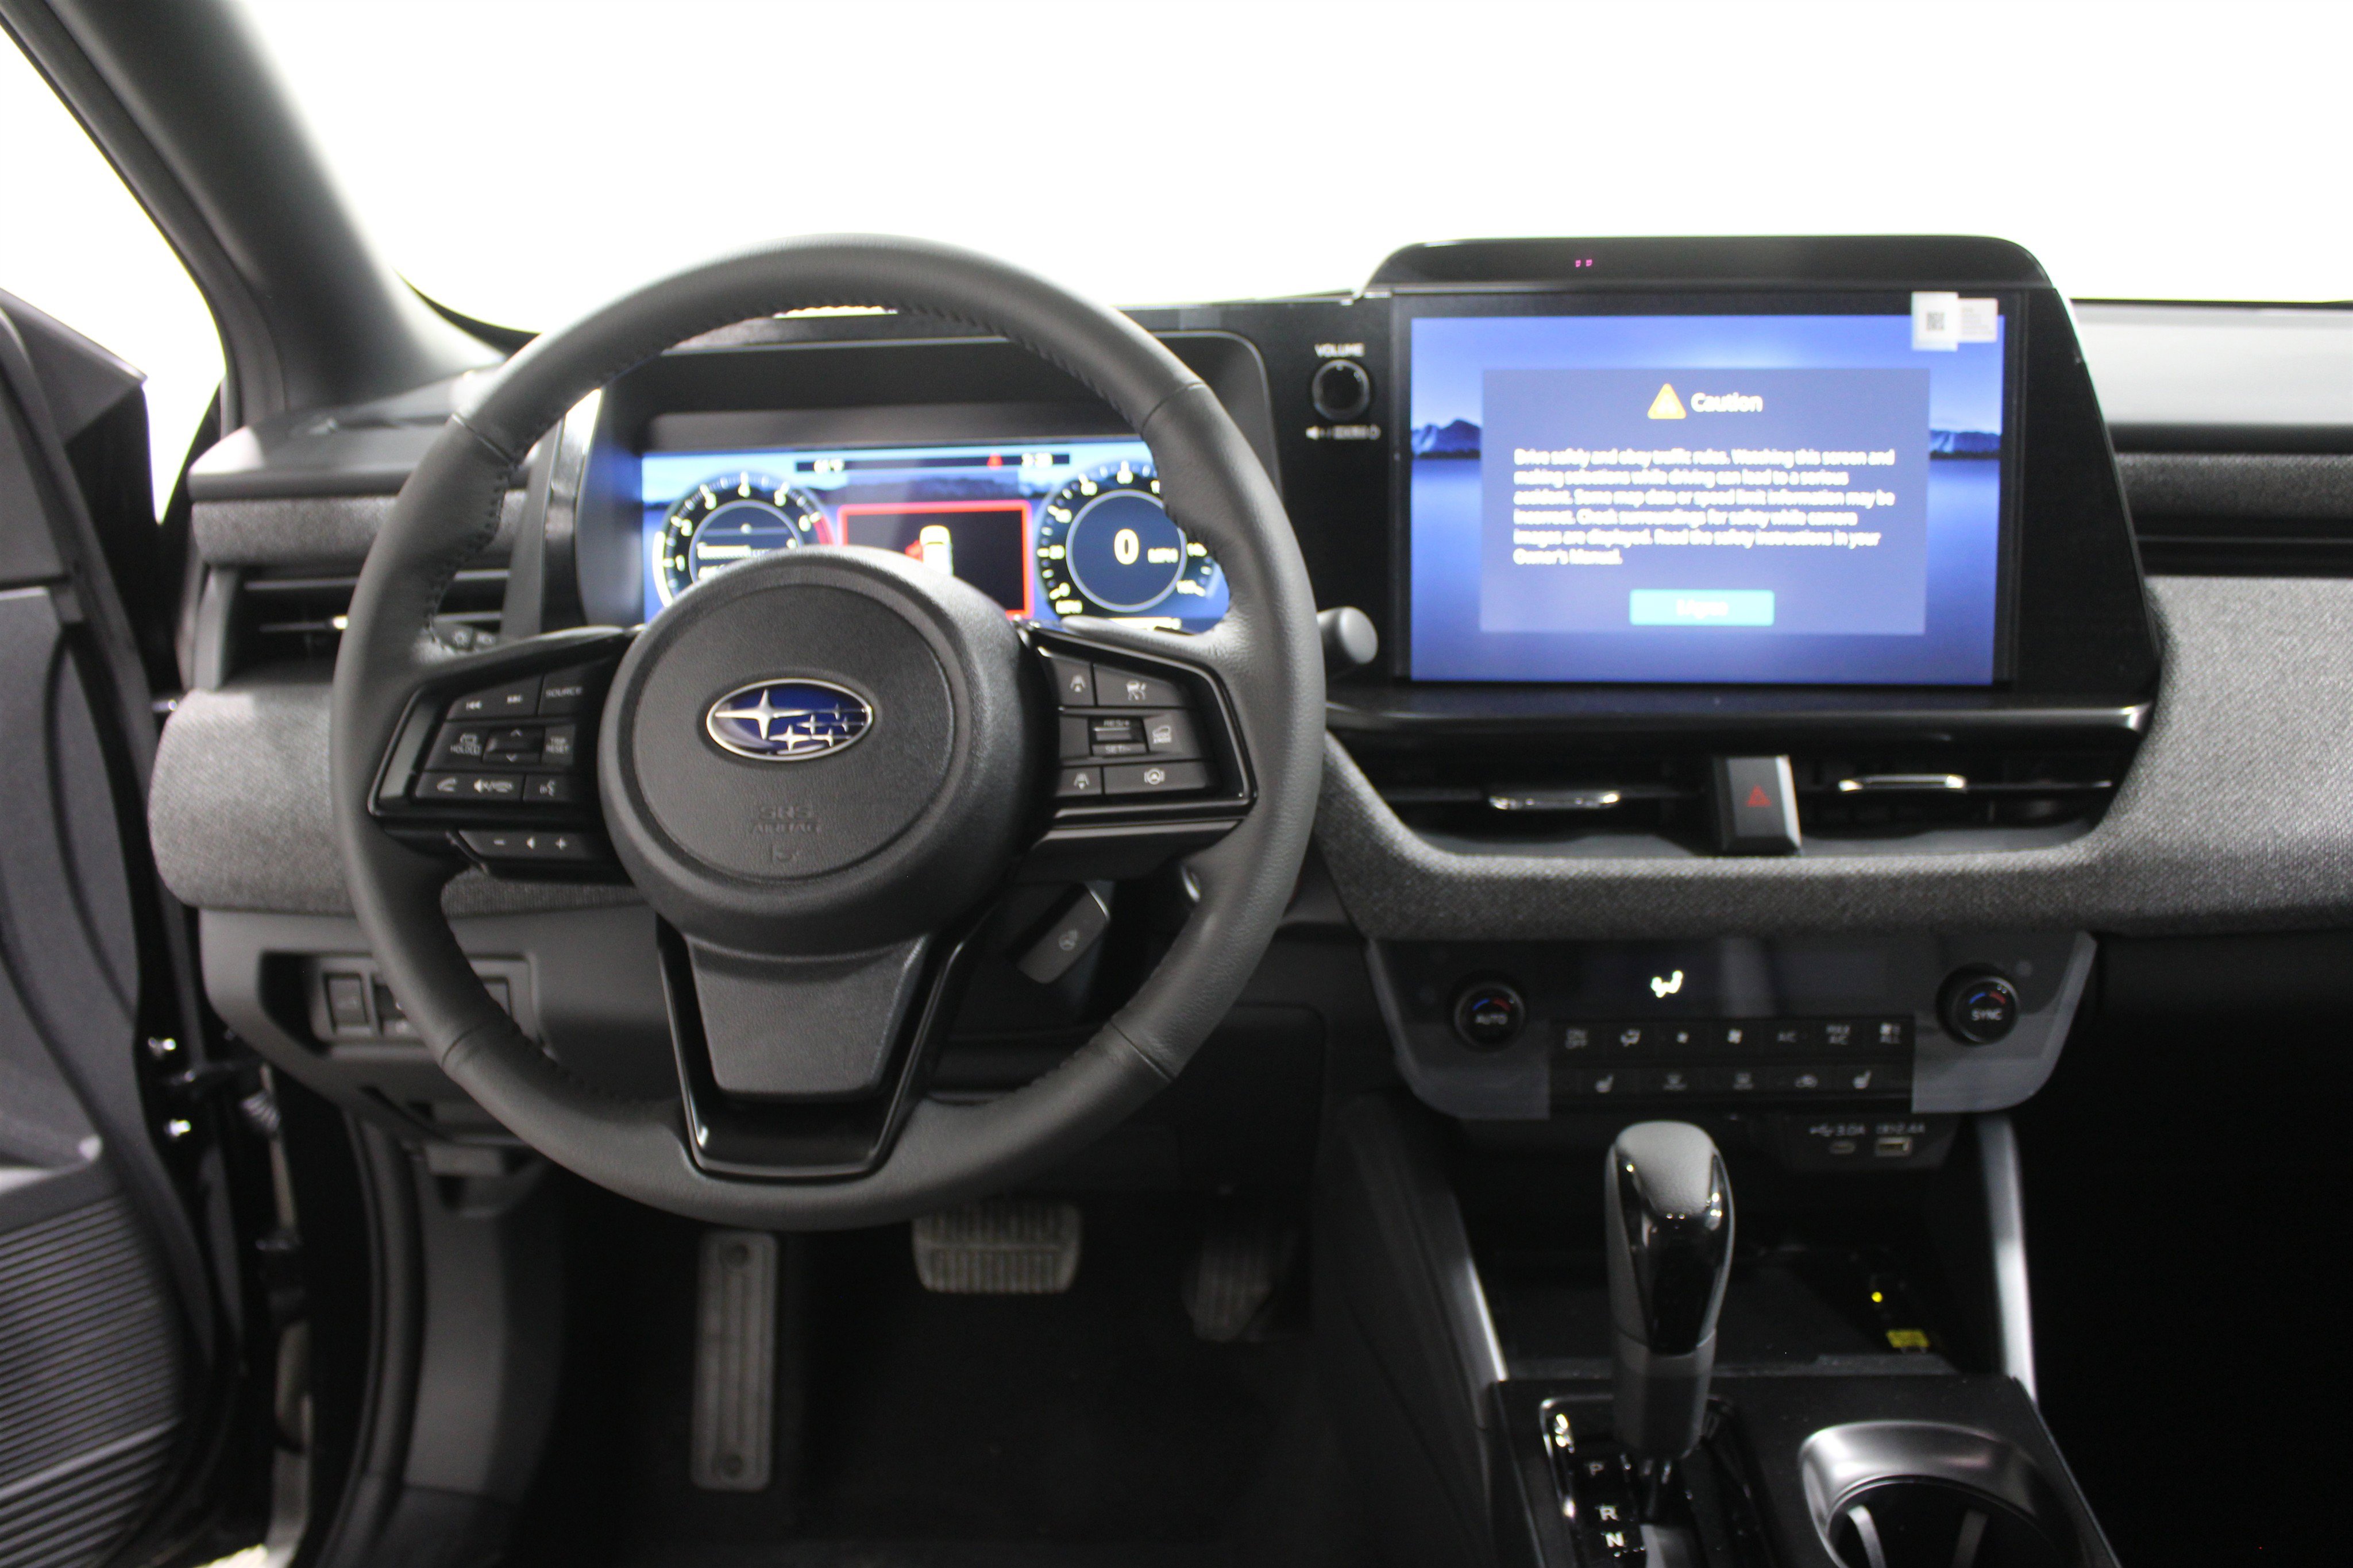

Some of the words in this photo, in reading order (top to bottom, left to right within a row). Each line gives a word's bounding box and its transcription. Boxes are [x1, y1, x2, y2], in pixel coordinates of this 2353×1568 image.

[1314, 342, 1365, 357] VOLUME
[1691, 392, 1763, 412] Caution
[1114, 528, 1139, 566] 0
[546, 686, 583, 698] SOURCE
[1475, 1013, 1508, 1025] AUTO
[1972, 1009, 2002, 1021] SYNC
[1590, 1462, 1603, 1476] P
[1599, 1505, 1618, 1520] R
[1606, 1532, 1624, 1547] N
